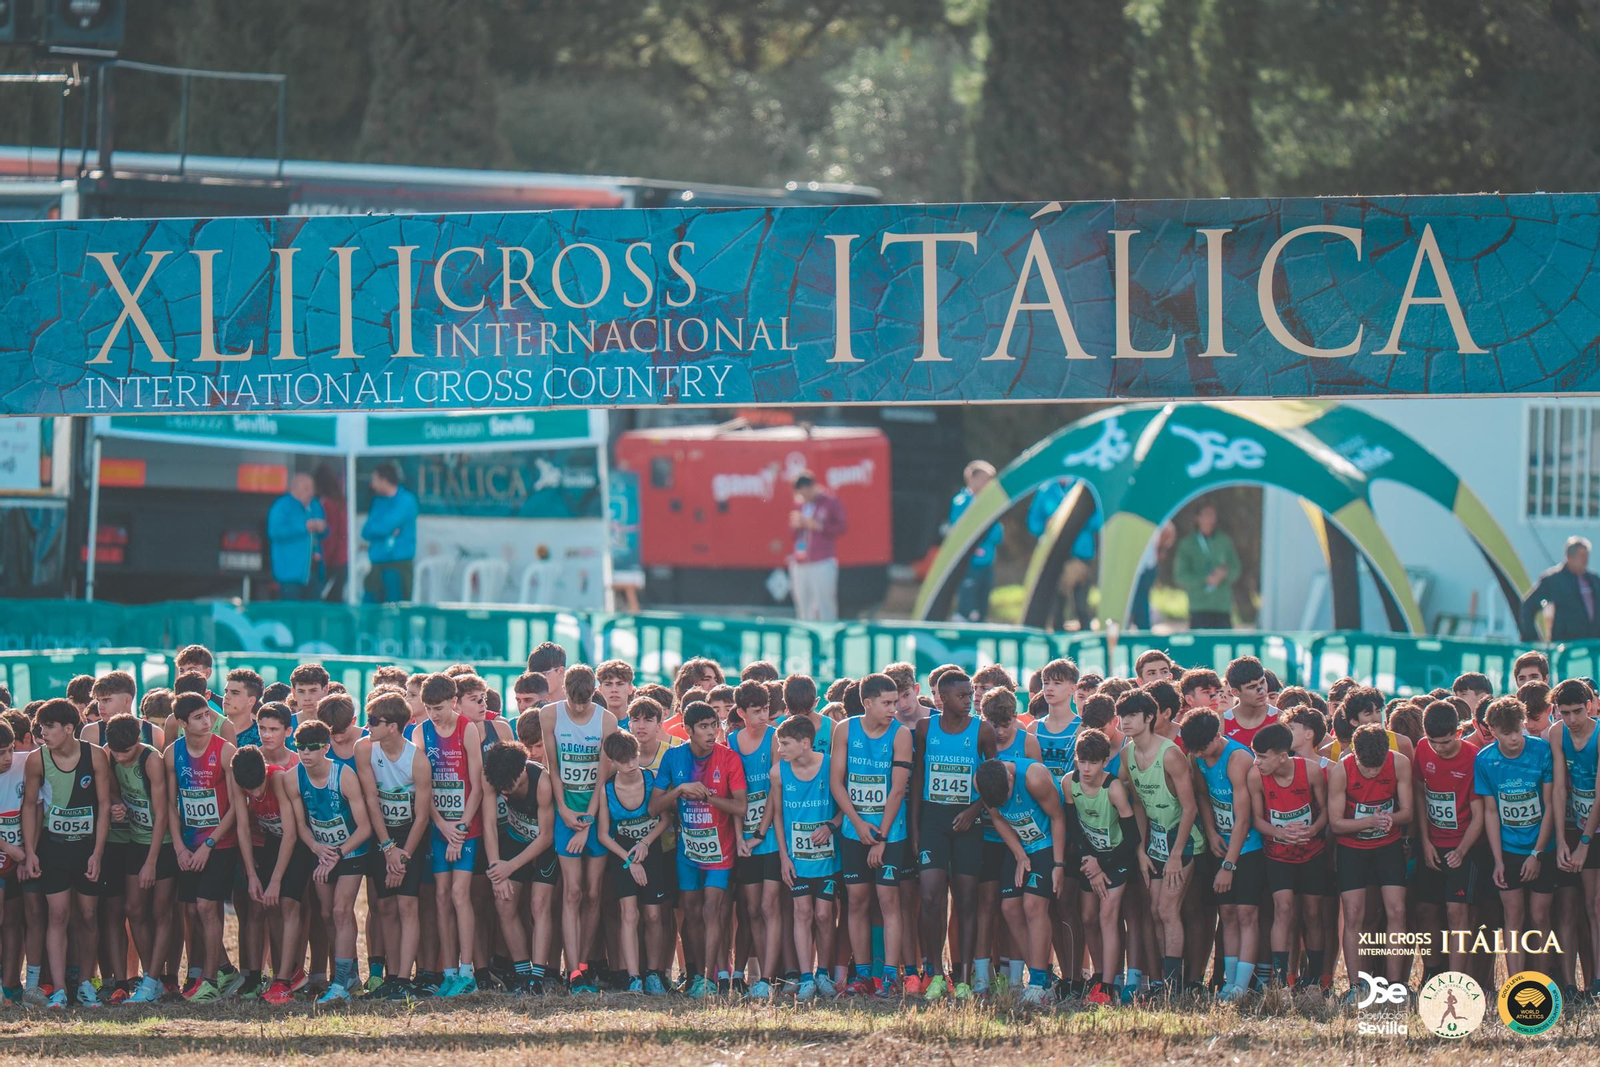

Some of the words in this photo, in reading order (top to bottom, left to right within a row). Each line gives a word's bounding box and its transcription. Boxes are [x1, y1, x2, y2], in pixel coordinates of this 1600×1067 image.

[825, 202, 1489, 363] ITÁLICA
[86, 245, 424, 364] XLIII
[434, 241, 699, 312] CROSS
[436, 316, 799, 357] INTERNACIONAL
[86, 373, 404, 410] INTERNATIONAL
[415, 369, 533, 403] CROSS
[543, 364, 733, 400] COUNTRY
[849, 756, 892, 769] TROTAERRA
[564, 767, 598, 781] 5976
[932, 778, 968, 793] 8145
[850, 788, 884, 803] 8140
[186, 803, 216, 817] 8100
[784, 799, 830, 809] TROTASIERRA
[682, 813, 713, 824] DELSUR
[1503, 804, 1539, 819] 6021
[53, 820, 90, 832] 6054
[621, 822, 656, 839] 8085
[315, 829, 347, 843] 6018
[686, 839, 718, 853] 8099
